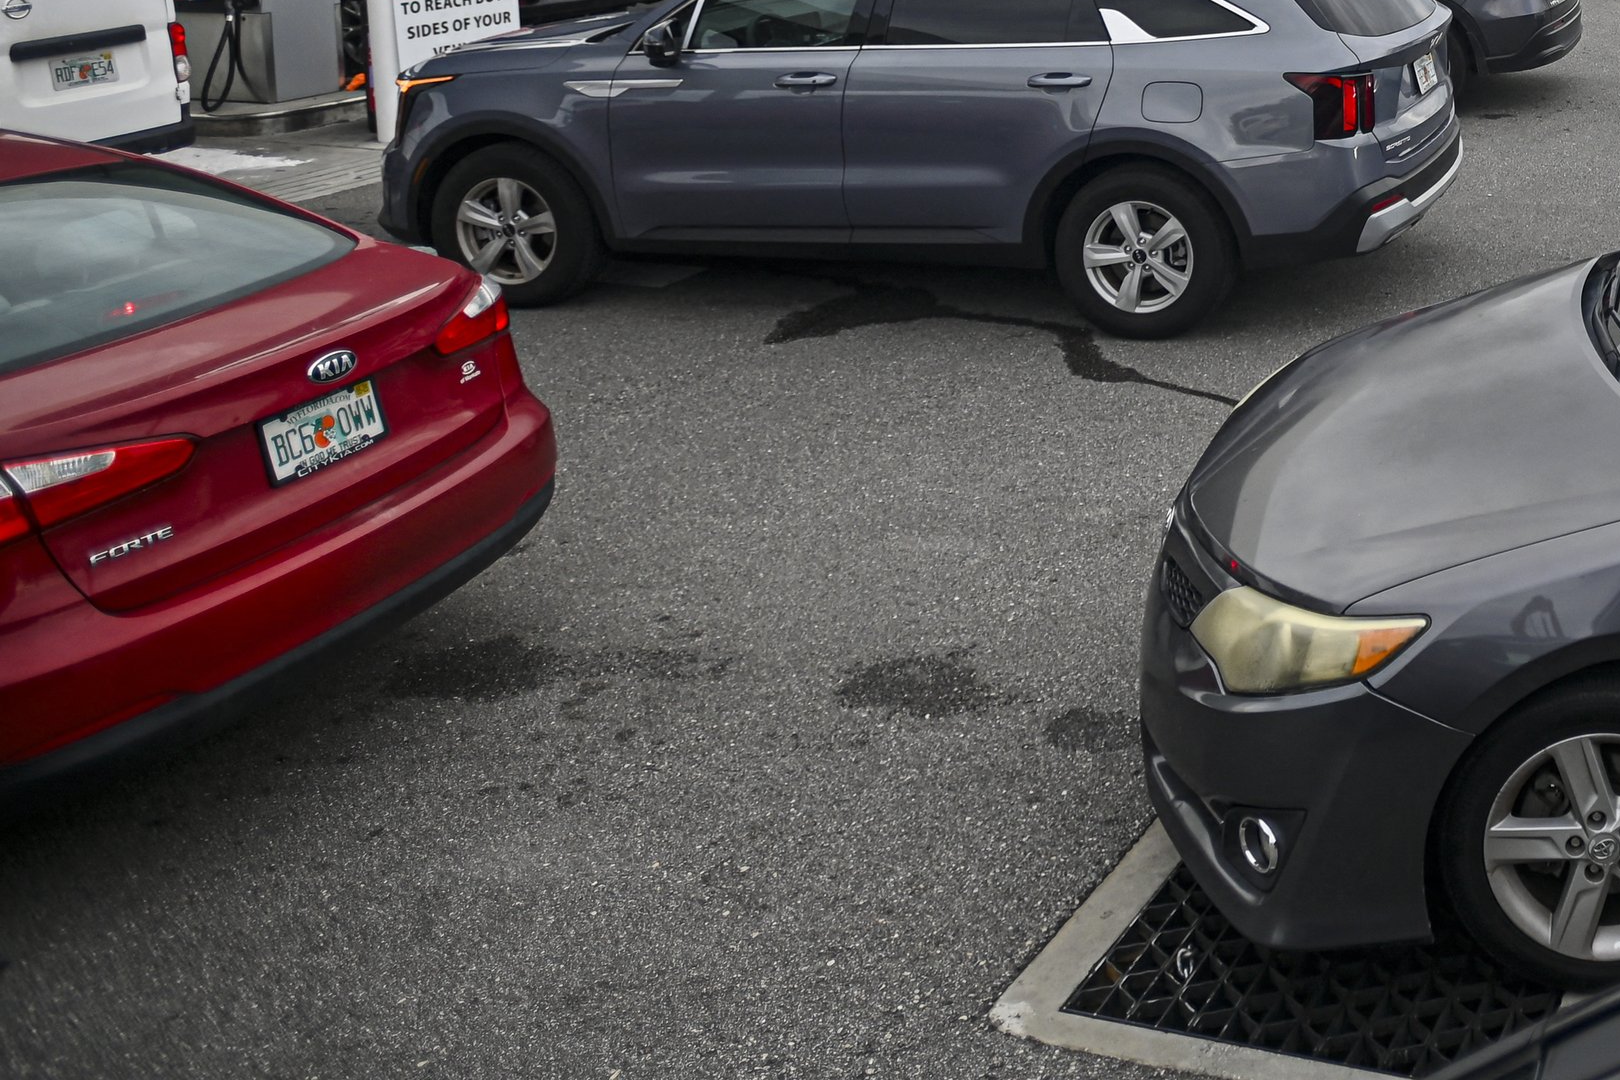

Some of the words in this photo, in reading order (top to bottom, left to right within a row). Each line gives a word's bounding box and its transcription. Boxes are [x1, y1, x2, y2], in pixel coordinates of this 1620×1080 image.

[400, 1, 420, 15] TO
[407, 21, 449, 39] SIDES
[452, 17, 471, 32] OF
[473, 11, 511, 28] YOUR
[317, 354, 353, 380] KIA
[271, 422, 315, 467] BC6
[297, 439, 374, 477] CITYKIA.COM
[308, 450, 325, 466] GOD
[326, 445, 337, 457] WE
[339, 434, 363, 451] TRUST
[89, 526, 174, 566] FORTE
